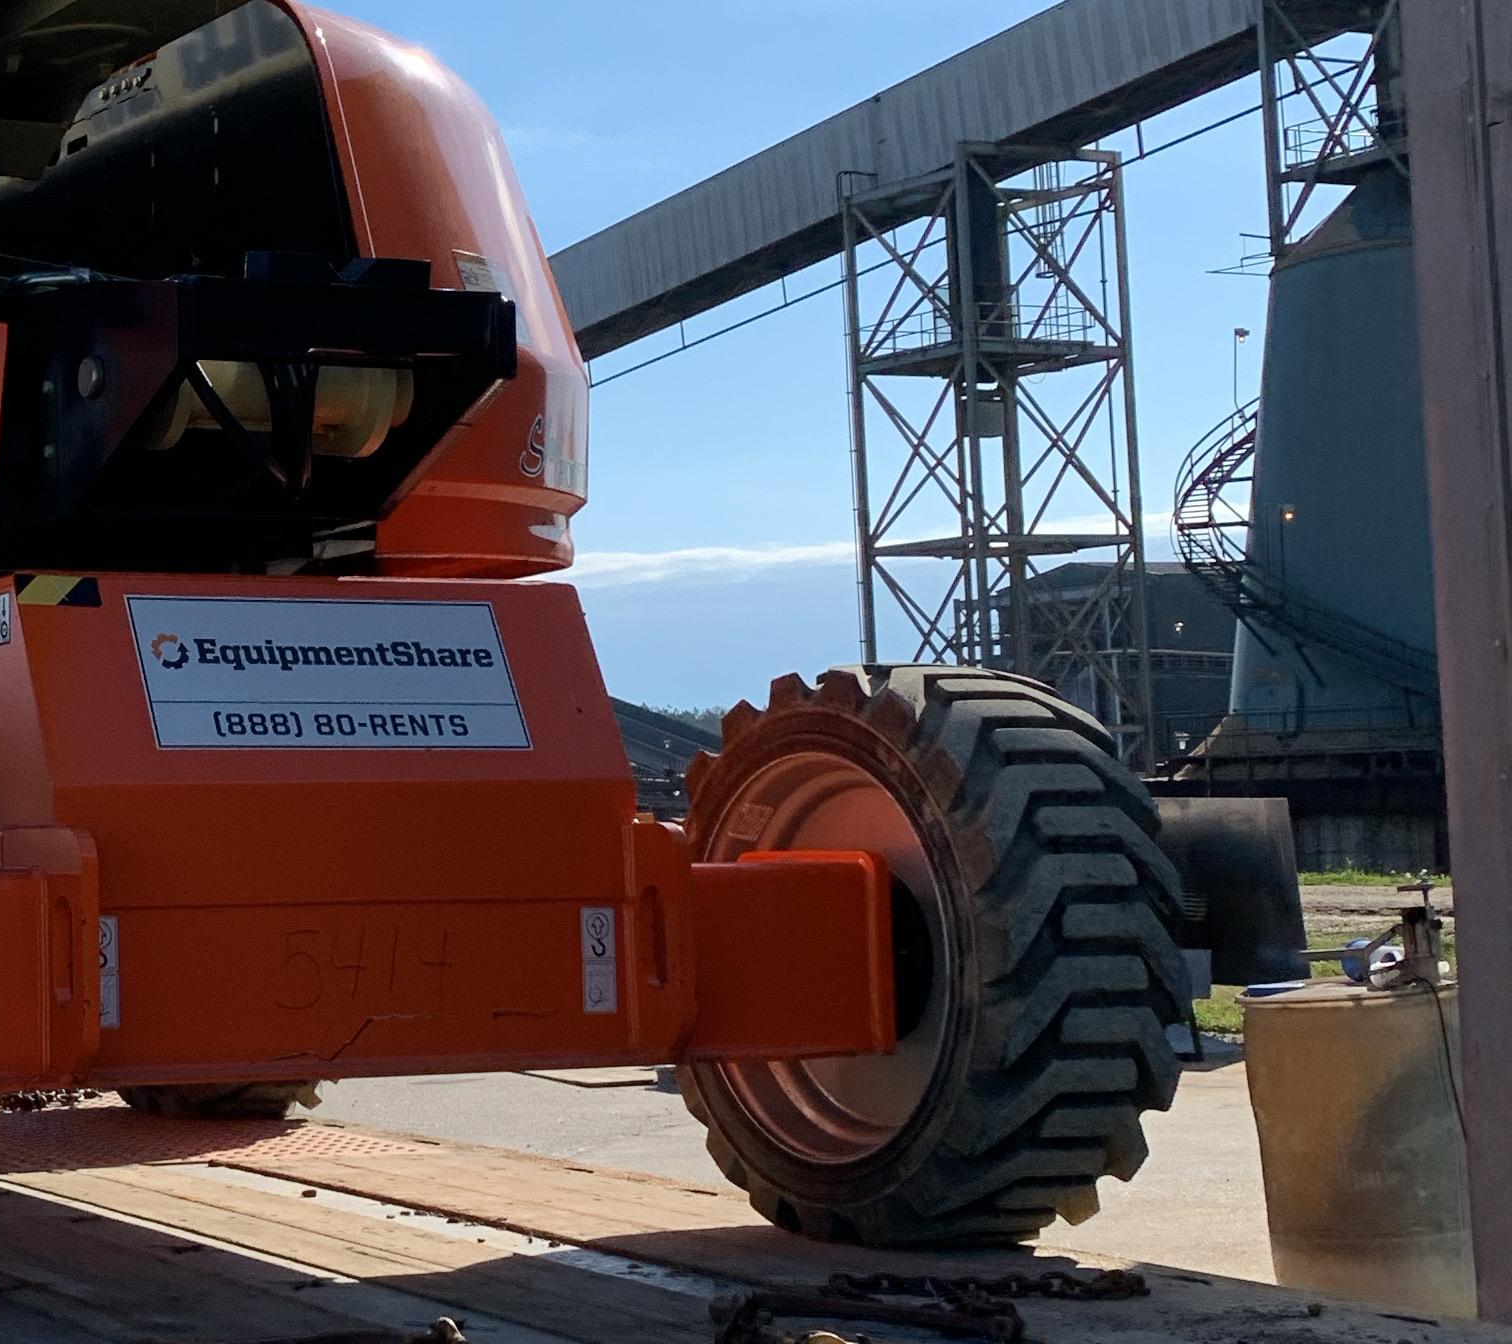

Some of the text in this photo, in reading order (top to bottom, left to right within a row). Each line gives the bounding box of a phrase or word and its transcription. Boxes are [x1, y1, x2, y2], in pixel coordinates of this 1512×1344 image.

[193, 638, 494, 671] EquipmentShare
[213, 711, 470, 738] (888) 80-RENTS
